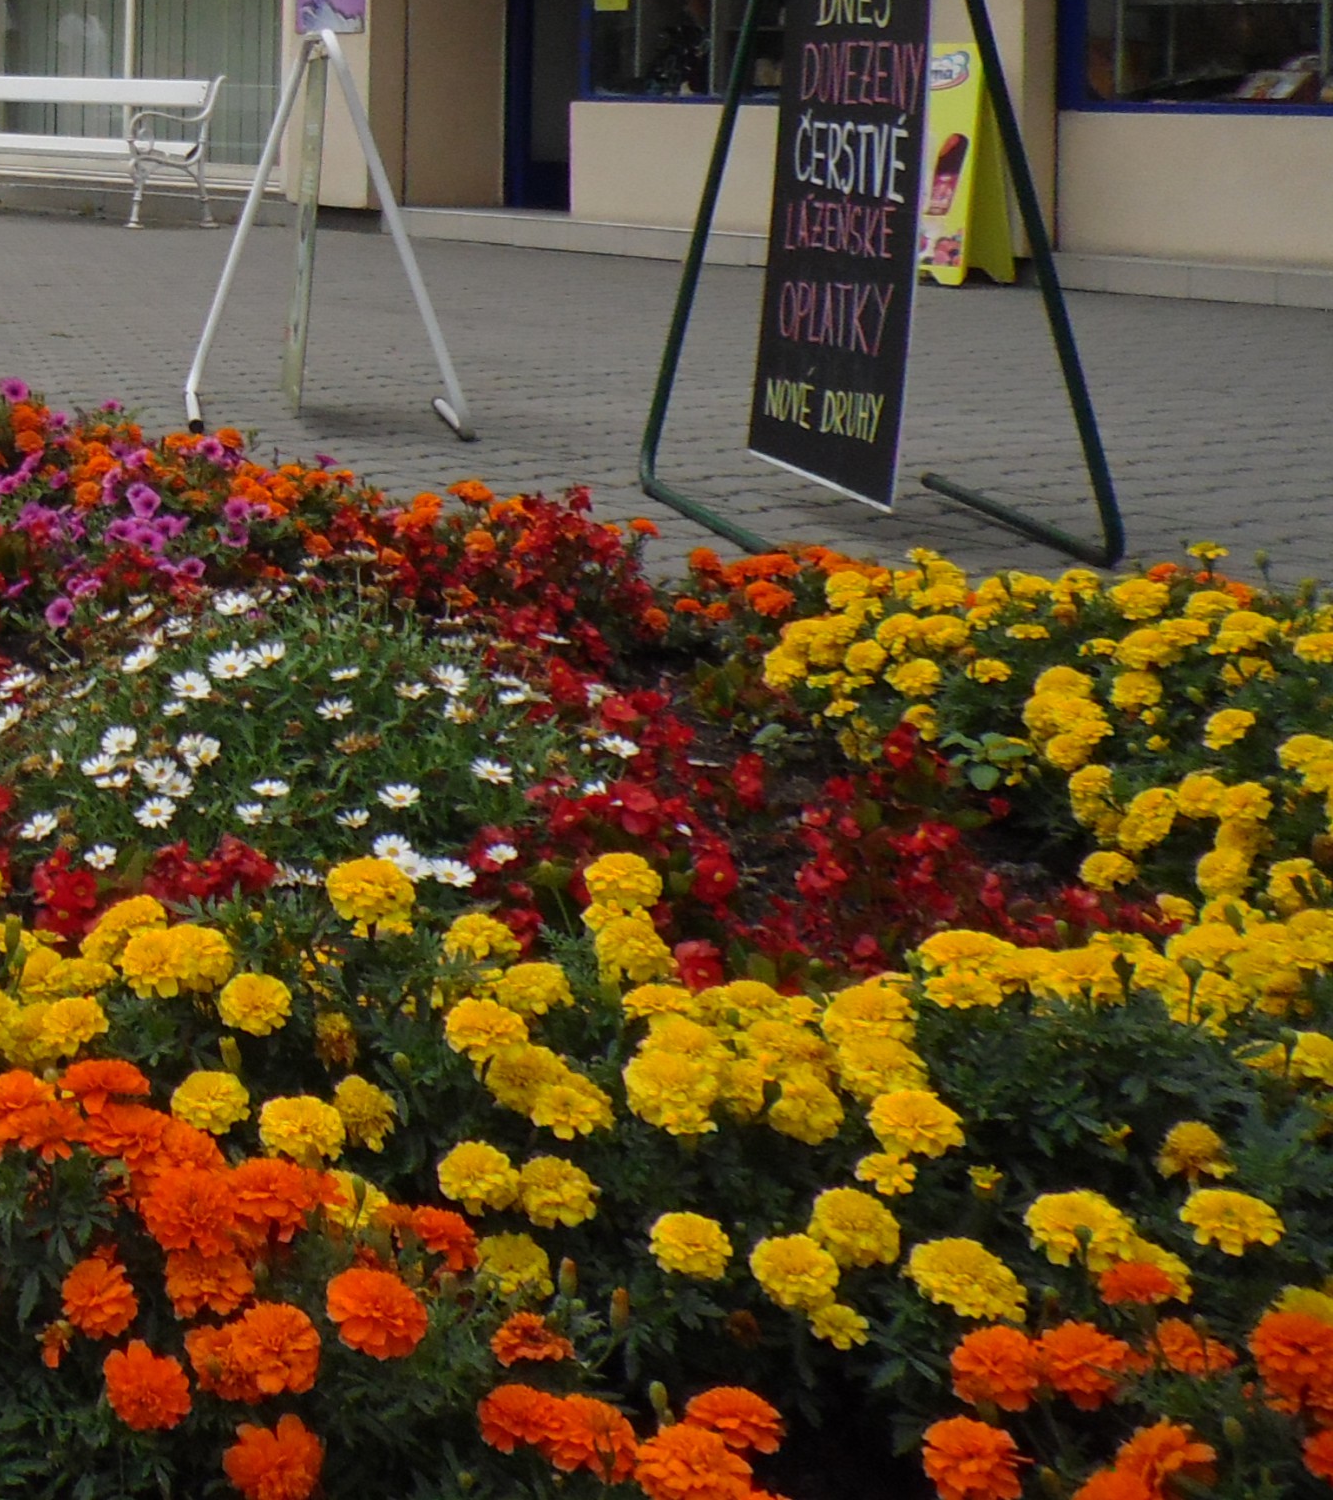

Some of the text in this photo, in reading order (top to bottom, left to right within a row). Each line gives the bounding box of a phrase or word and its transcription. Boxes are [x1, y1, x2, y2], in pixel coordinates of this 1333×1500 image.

[794, 109, 910, 204] ČERSTVÉ
[779, 281, 895, 358] OPLATKY
[763, 365, 886, 445] NOVÉ DRUHY
